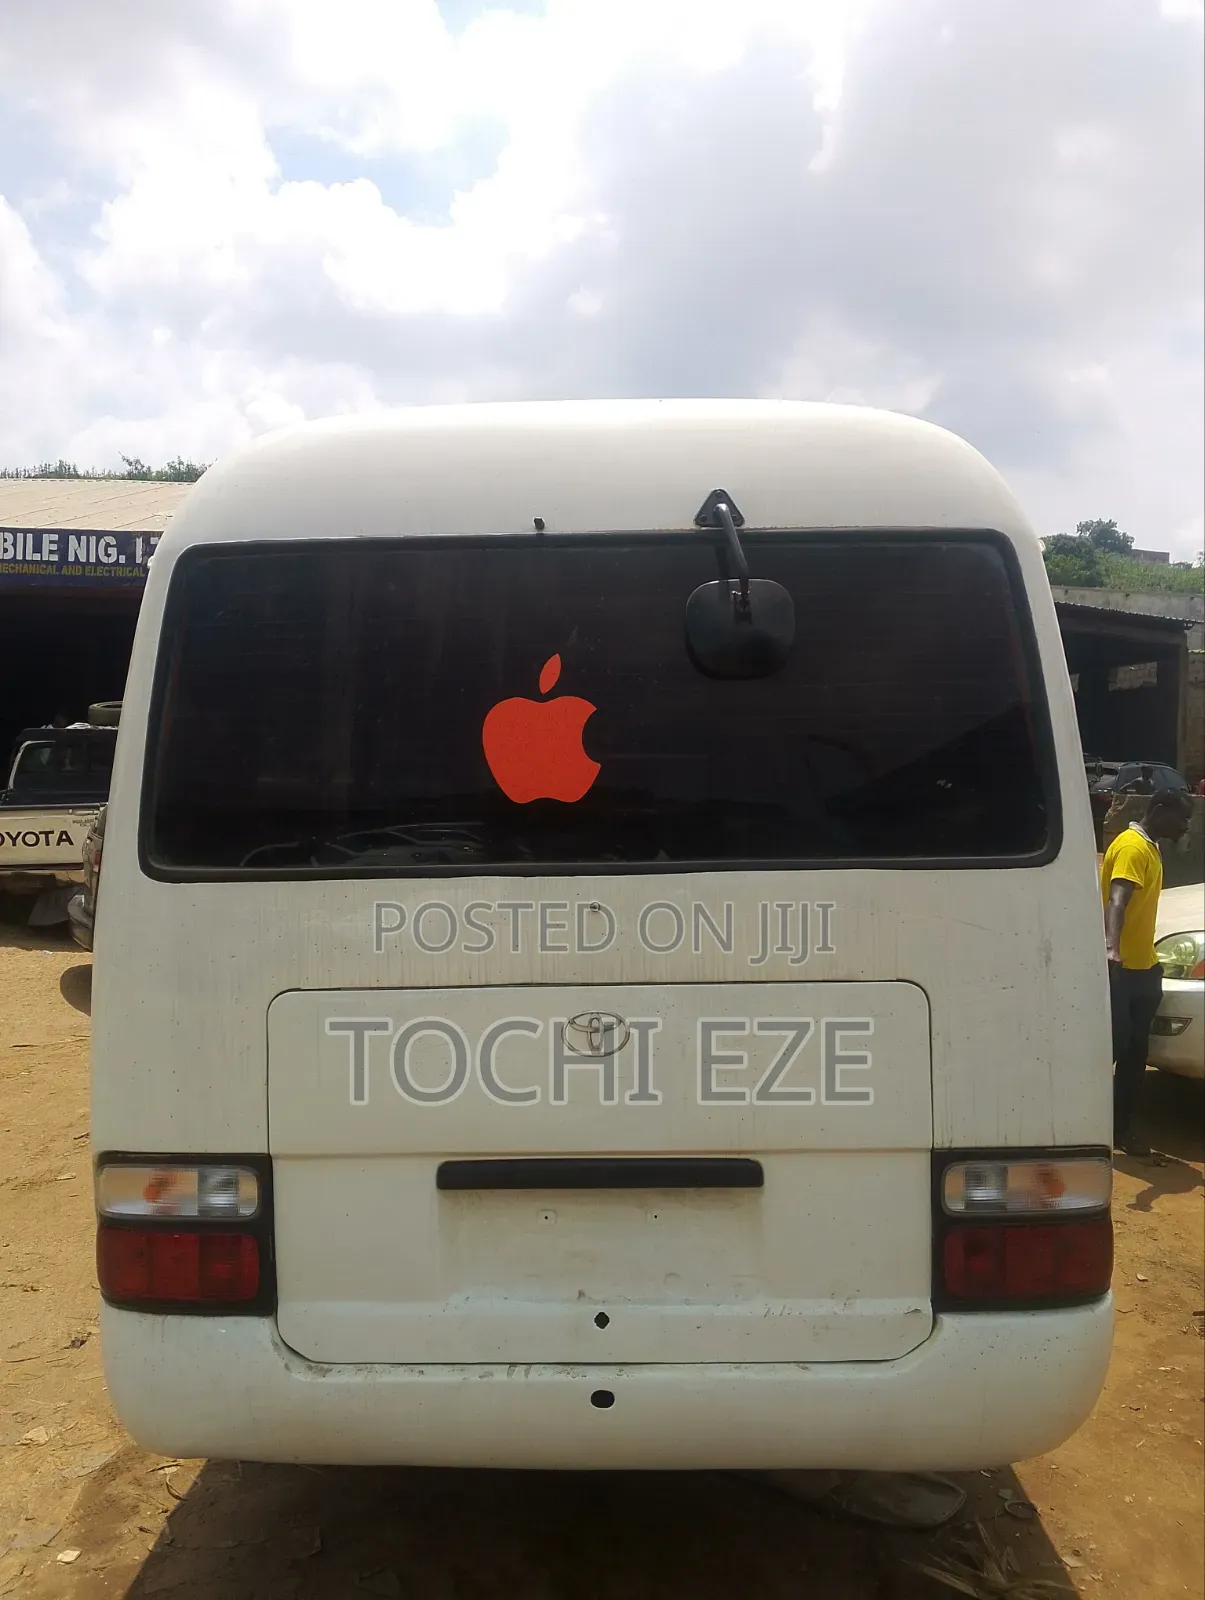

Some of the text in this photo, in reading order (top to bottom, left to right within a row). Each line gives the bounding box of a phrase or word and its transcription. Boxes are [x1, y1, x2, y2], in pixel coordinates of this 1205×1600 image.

[0, 532, 59, 561] BILE
[68, 535, 126, 563] NIG.
[0, 563, 145, 577] ECHANICAL AND ELECTRICAL
[0, 830, 75, 847] YOTA
